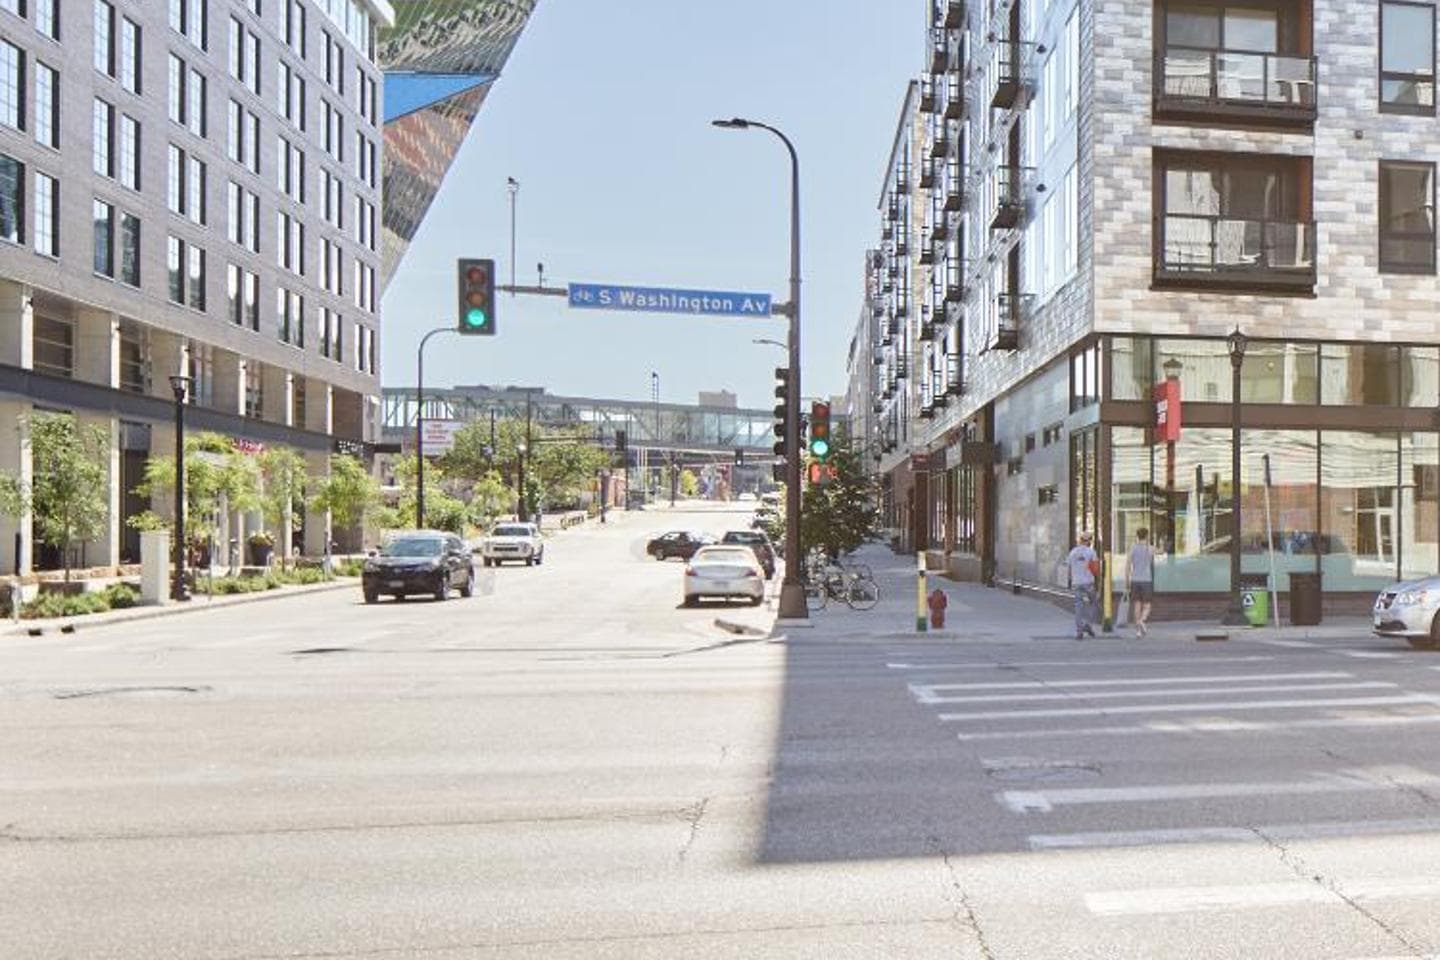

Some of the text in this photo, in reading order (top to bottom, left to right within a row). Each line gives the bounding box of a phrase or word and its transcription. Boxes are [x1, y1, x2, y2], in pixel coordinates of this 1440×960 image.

[599, 289, 767, 314] S Washington Av
